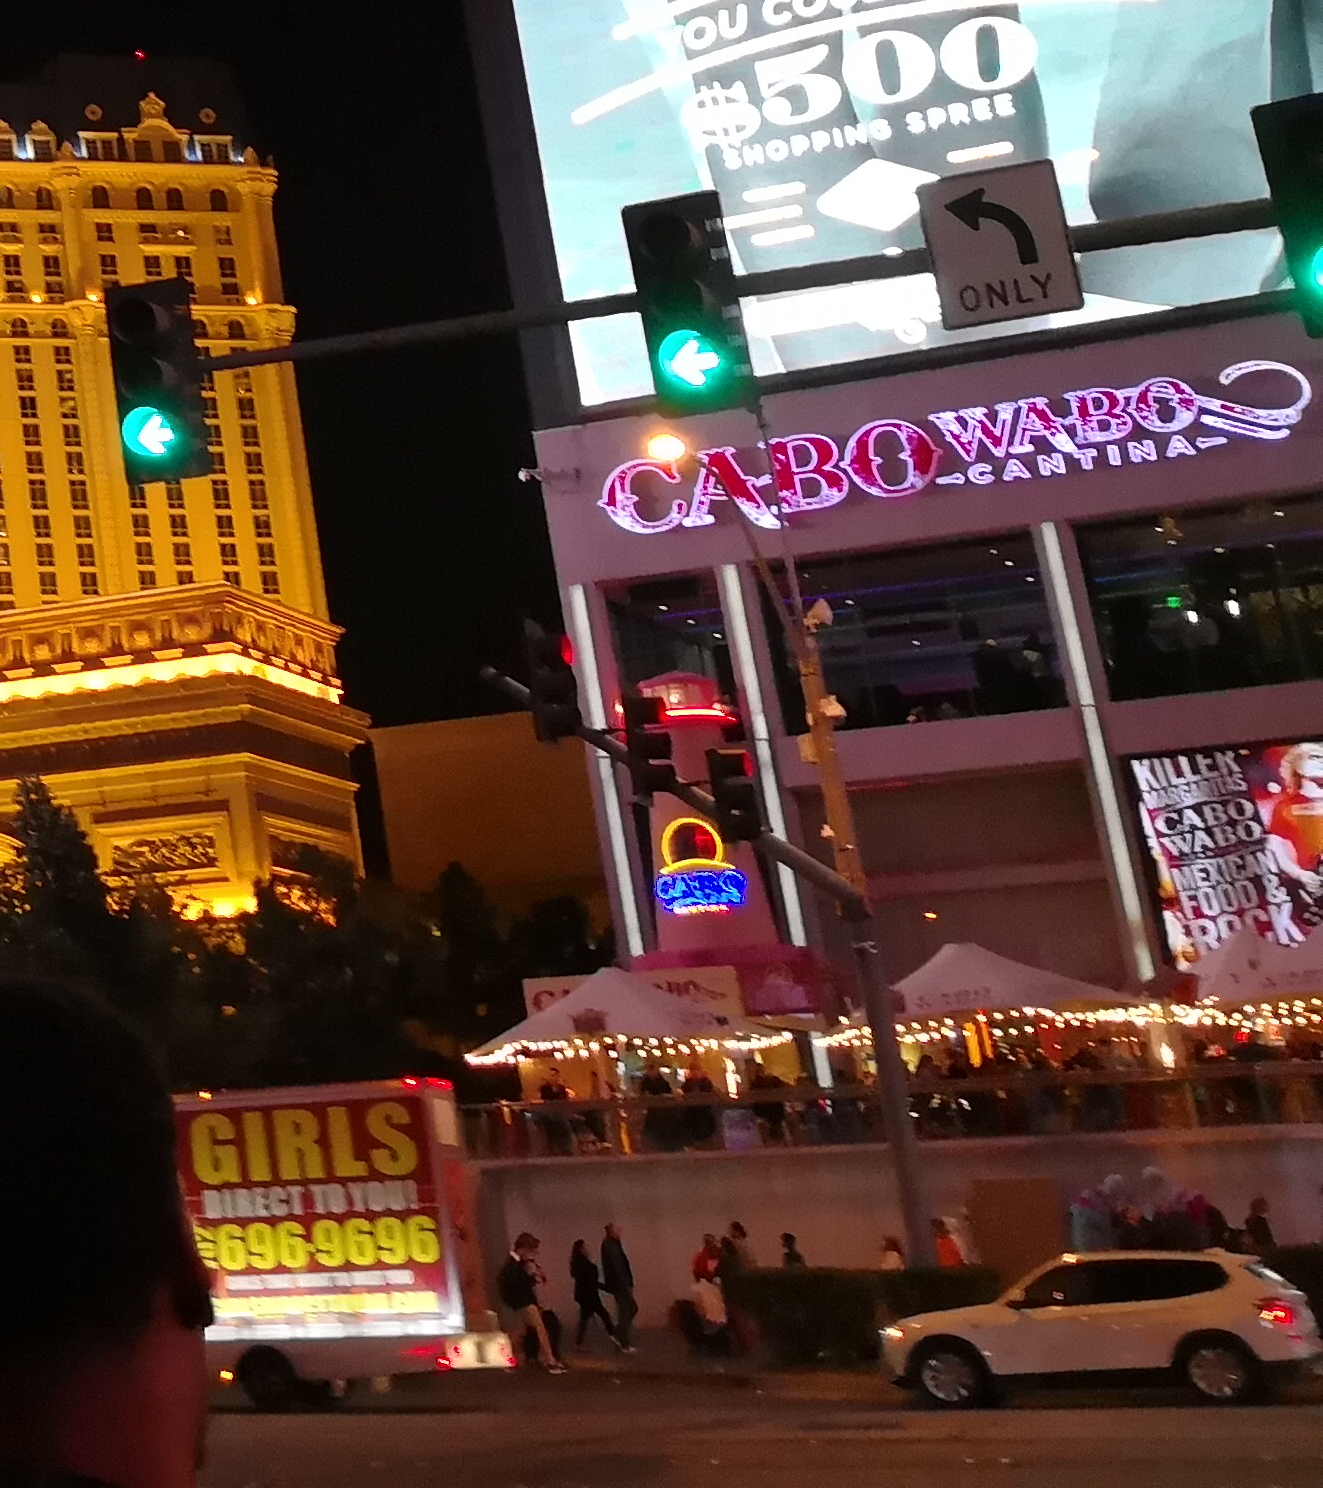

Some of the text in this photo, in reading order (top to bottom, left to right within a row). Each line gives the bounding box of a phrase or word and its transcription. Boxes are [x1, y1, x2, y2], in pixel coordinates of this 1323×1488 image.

[657, 2, 749, 52] YOU
[680, 16, 1039, 153] $500
[721, 93, 1018, 171] SHOPPING SPREE
[958, 272, 1053, 312] ONLY
[595, 376, 1198, 534] CABO WABO
[1154, 797, 1256, 835] CABO
[1158, 820, 1265, 858] WABO
[1169, 848, 1281, 892] MEXICAN
[1180, 880, 1259, 919] FOOD
[190, 1101, 419, 1185] GIRLS
[215, 1214, 441, 1272] 696-9696
